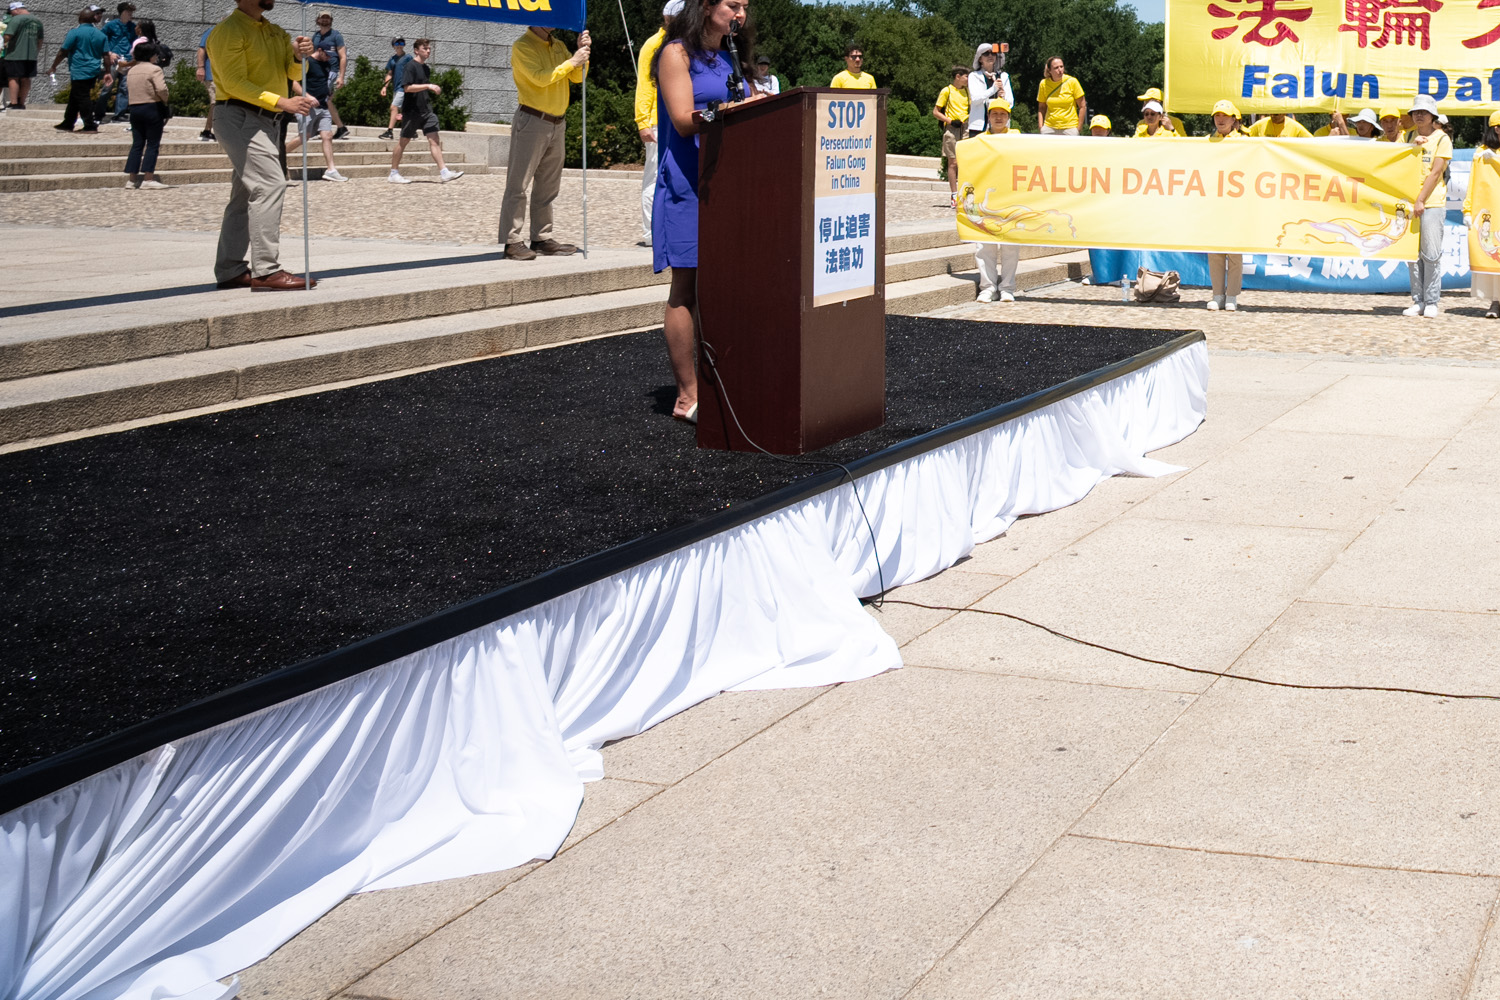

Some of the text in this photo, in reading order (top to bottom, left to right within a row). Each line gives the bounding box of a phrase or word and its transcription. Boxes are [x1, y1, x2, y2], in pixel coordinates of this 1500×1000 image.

[1242, 64, 1380, 99] Falun
[828, 100, 866, 129] STOP
[820, 135, 873, 151] Persecution of
[826, 155, 866, 171] Falun Gong
[831, 174, 860, 190] in China
[1012, 165, 1366, 204] FALUN DAFA IS GREAT
[819, 213, 871, 243] 停止迫害
[825, 245, 864, 274] 法輪功
